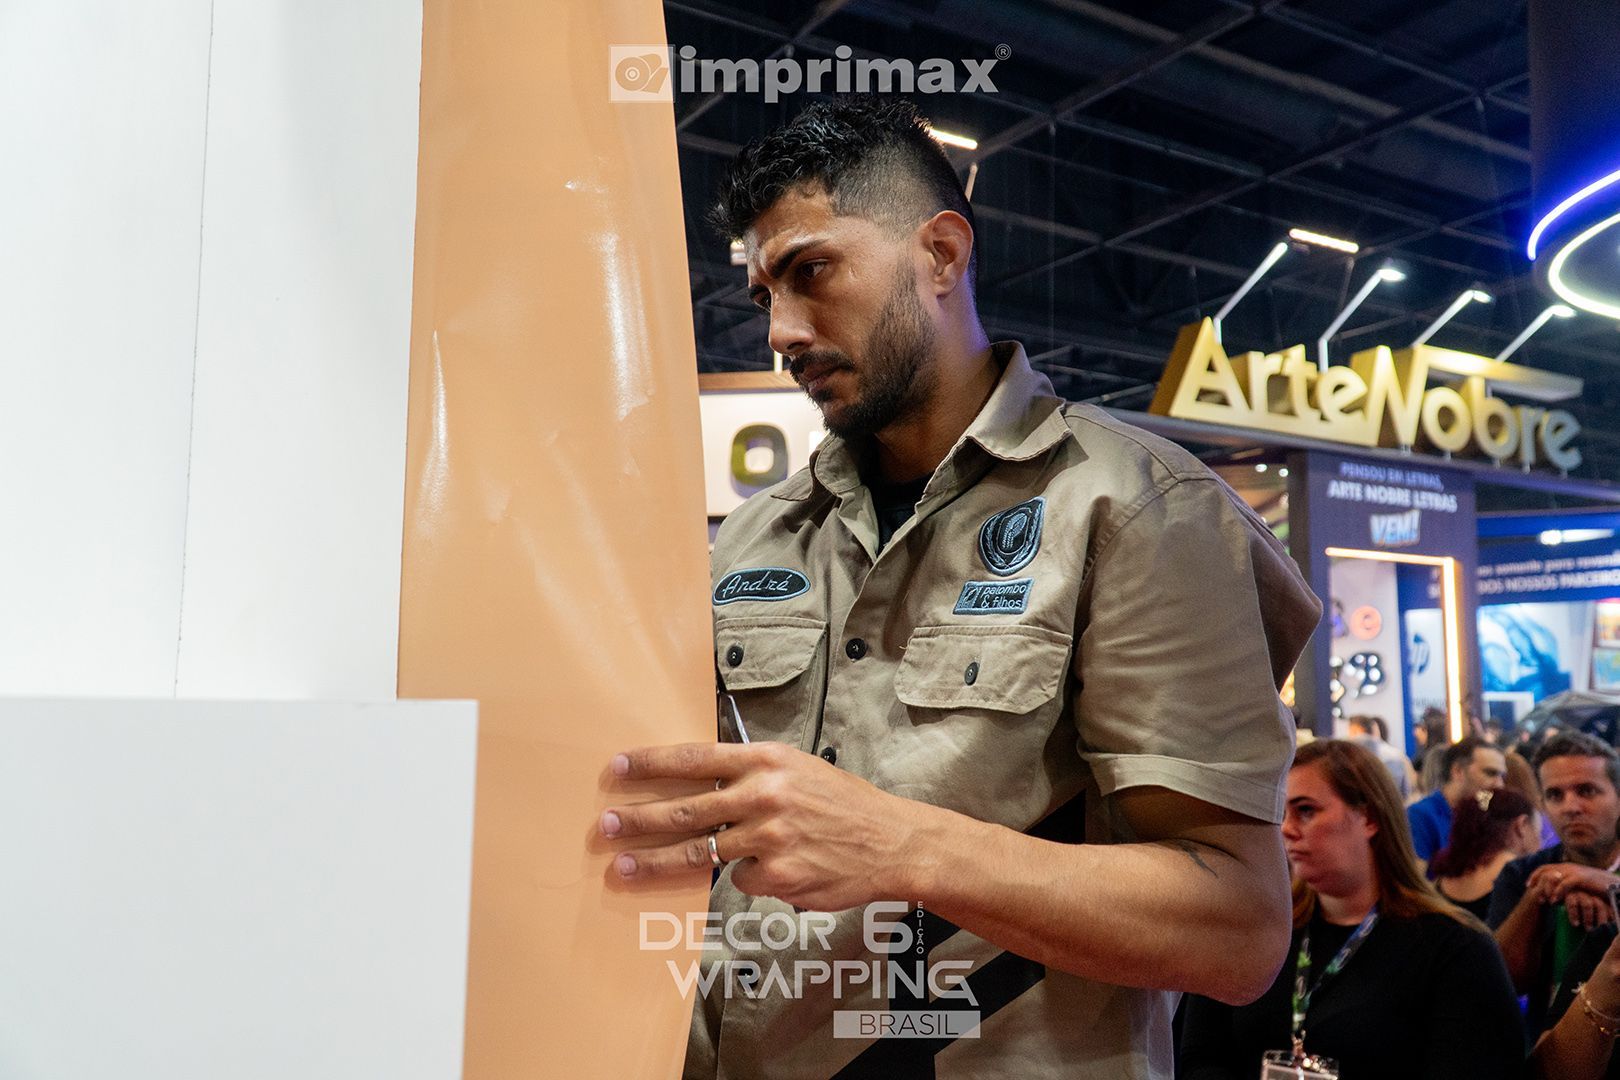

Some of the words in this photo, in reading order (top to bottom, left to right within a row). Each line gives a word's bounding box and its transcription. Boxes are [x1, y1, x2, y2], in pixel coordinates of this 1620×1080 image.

[1327, 479, 1363, 501] ARTE
[1363, 483, 1411, 507] NOBRE
[1412, 489, 1457, 513] LETRAS
[722, 571, 792, 598] André
[981, 584, 1027, 598] palombo
[992, 595, 1022, 609] filhos
